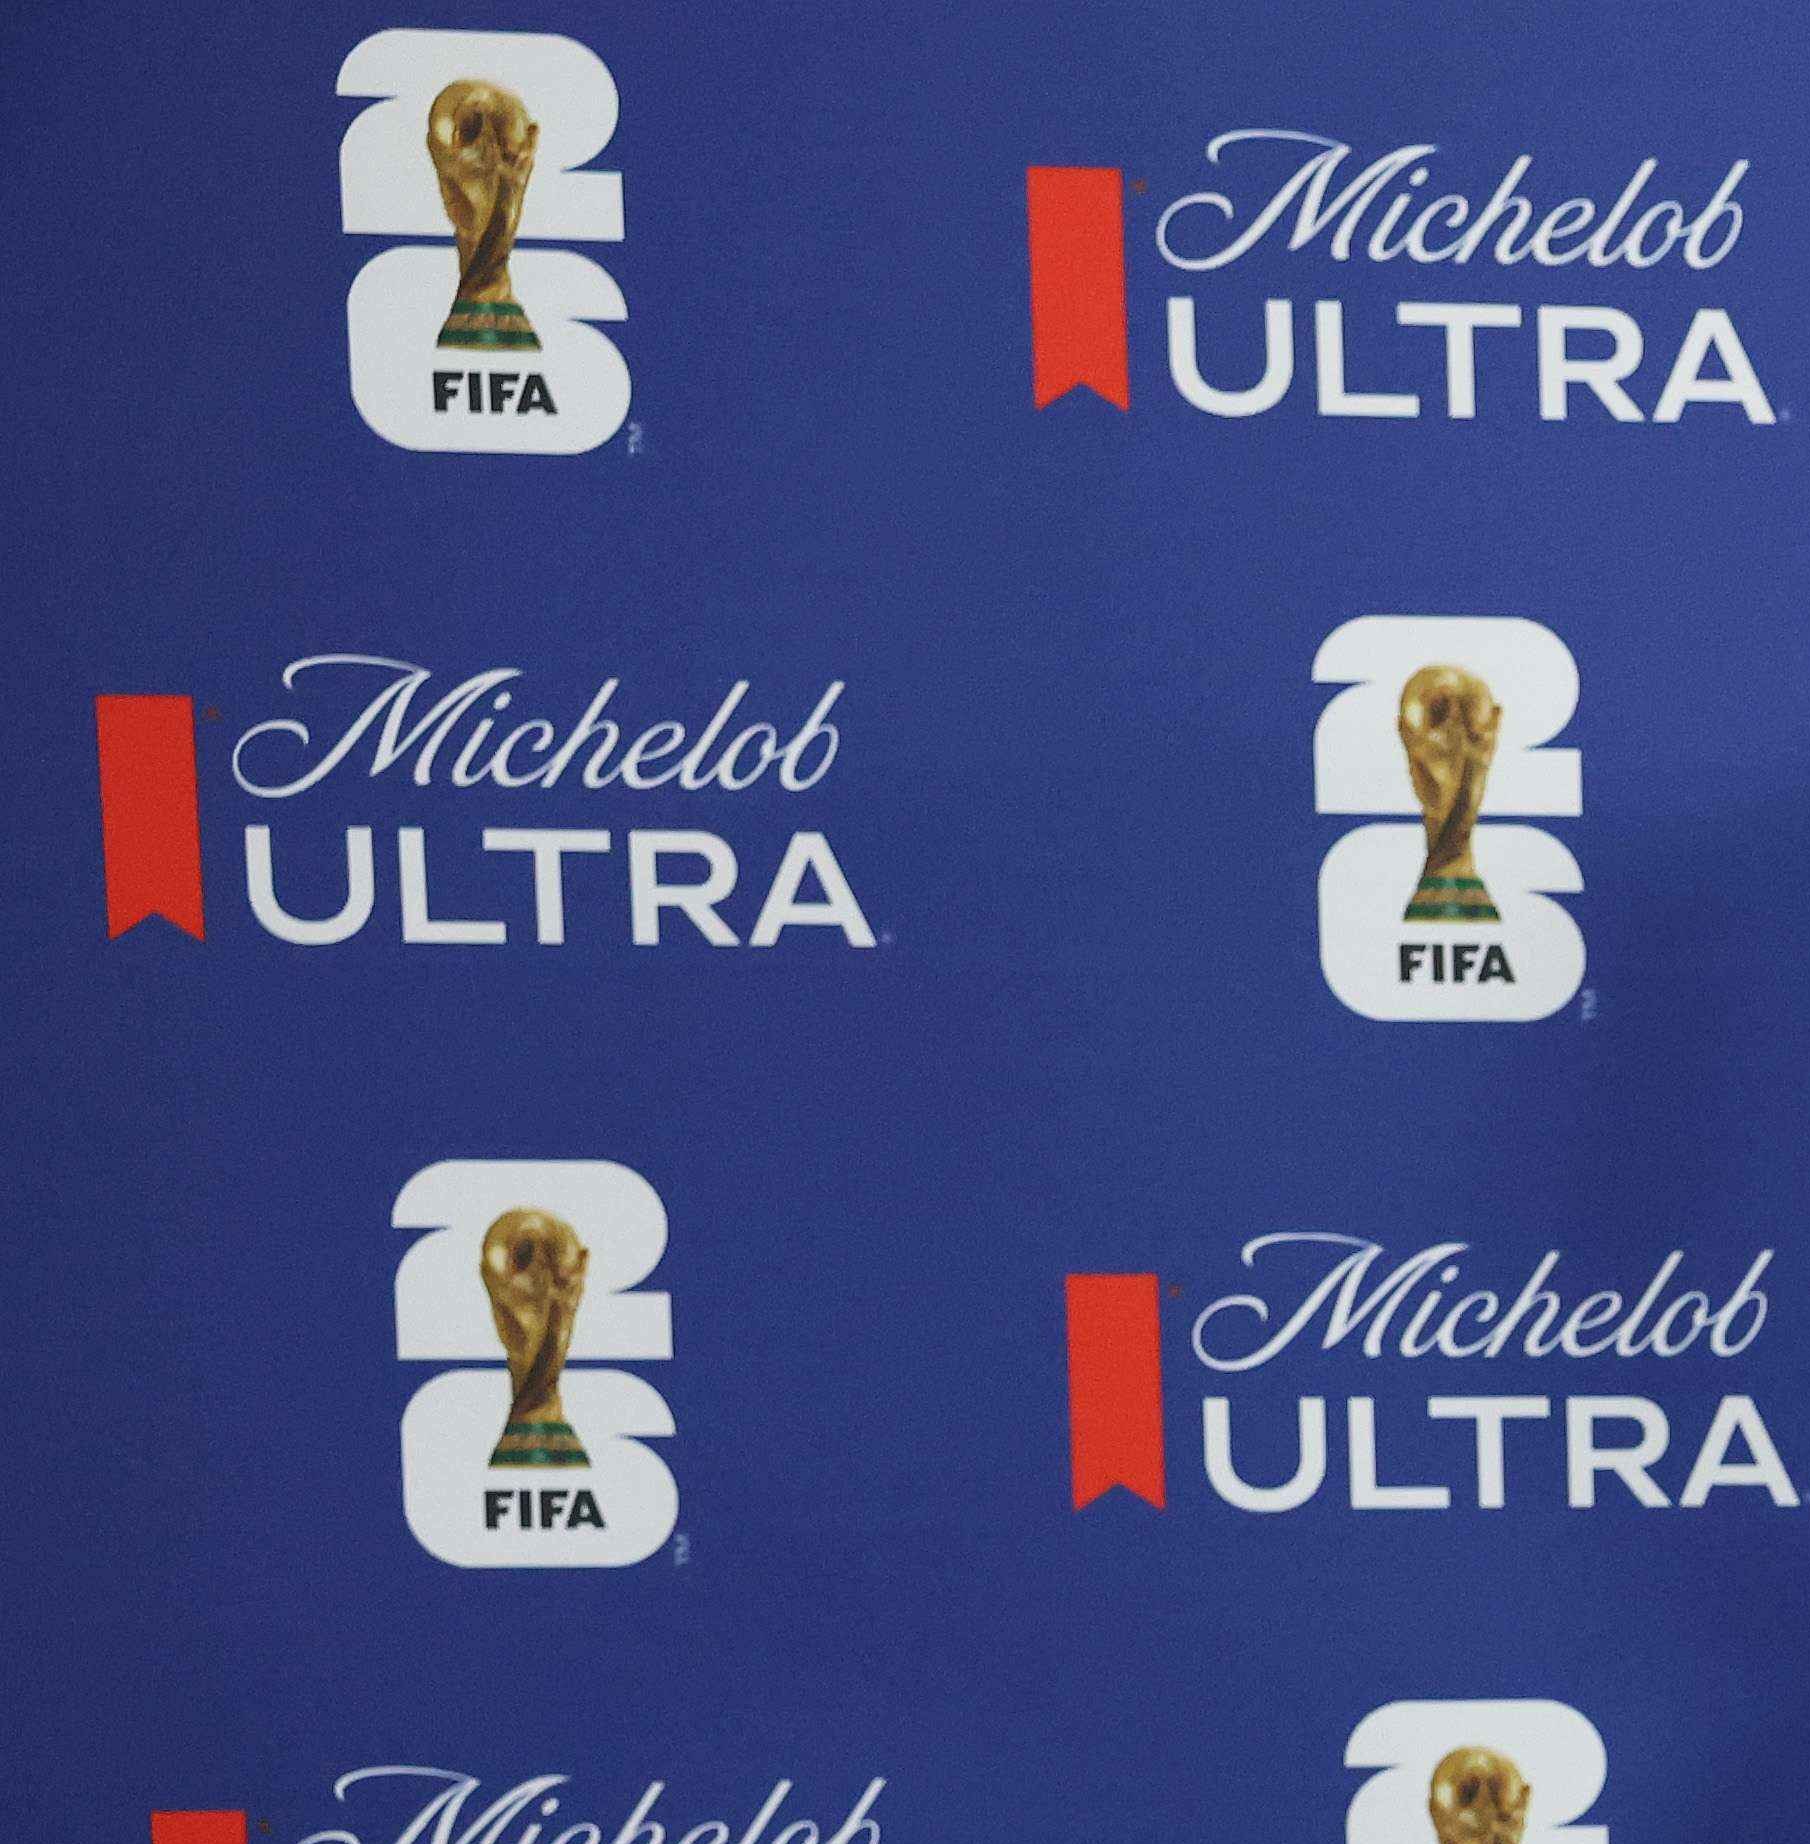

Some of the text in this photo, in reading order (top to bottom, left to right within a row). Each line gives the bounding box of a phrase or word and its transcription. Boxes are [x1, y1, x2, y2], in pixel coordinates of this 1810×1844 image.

[1156, 129, 1749, 270] Michelob
[433, 371, 557, 415] FIFA
[1168, 297, 1776, 424] ULTRA
[232, 654, 844, 798] Michelob
[245, 825, 876, 947] ULTRA
[1399, 943, 1515, 983] FIFA
[1192, 1232, 1773, 1371] Michelob
[484, 1490, 605, 1530] FIFA
[1203, 1396, 1800, 1512] ULTRA
